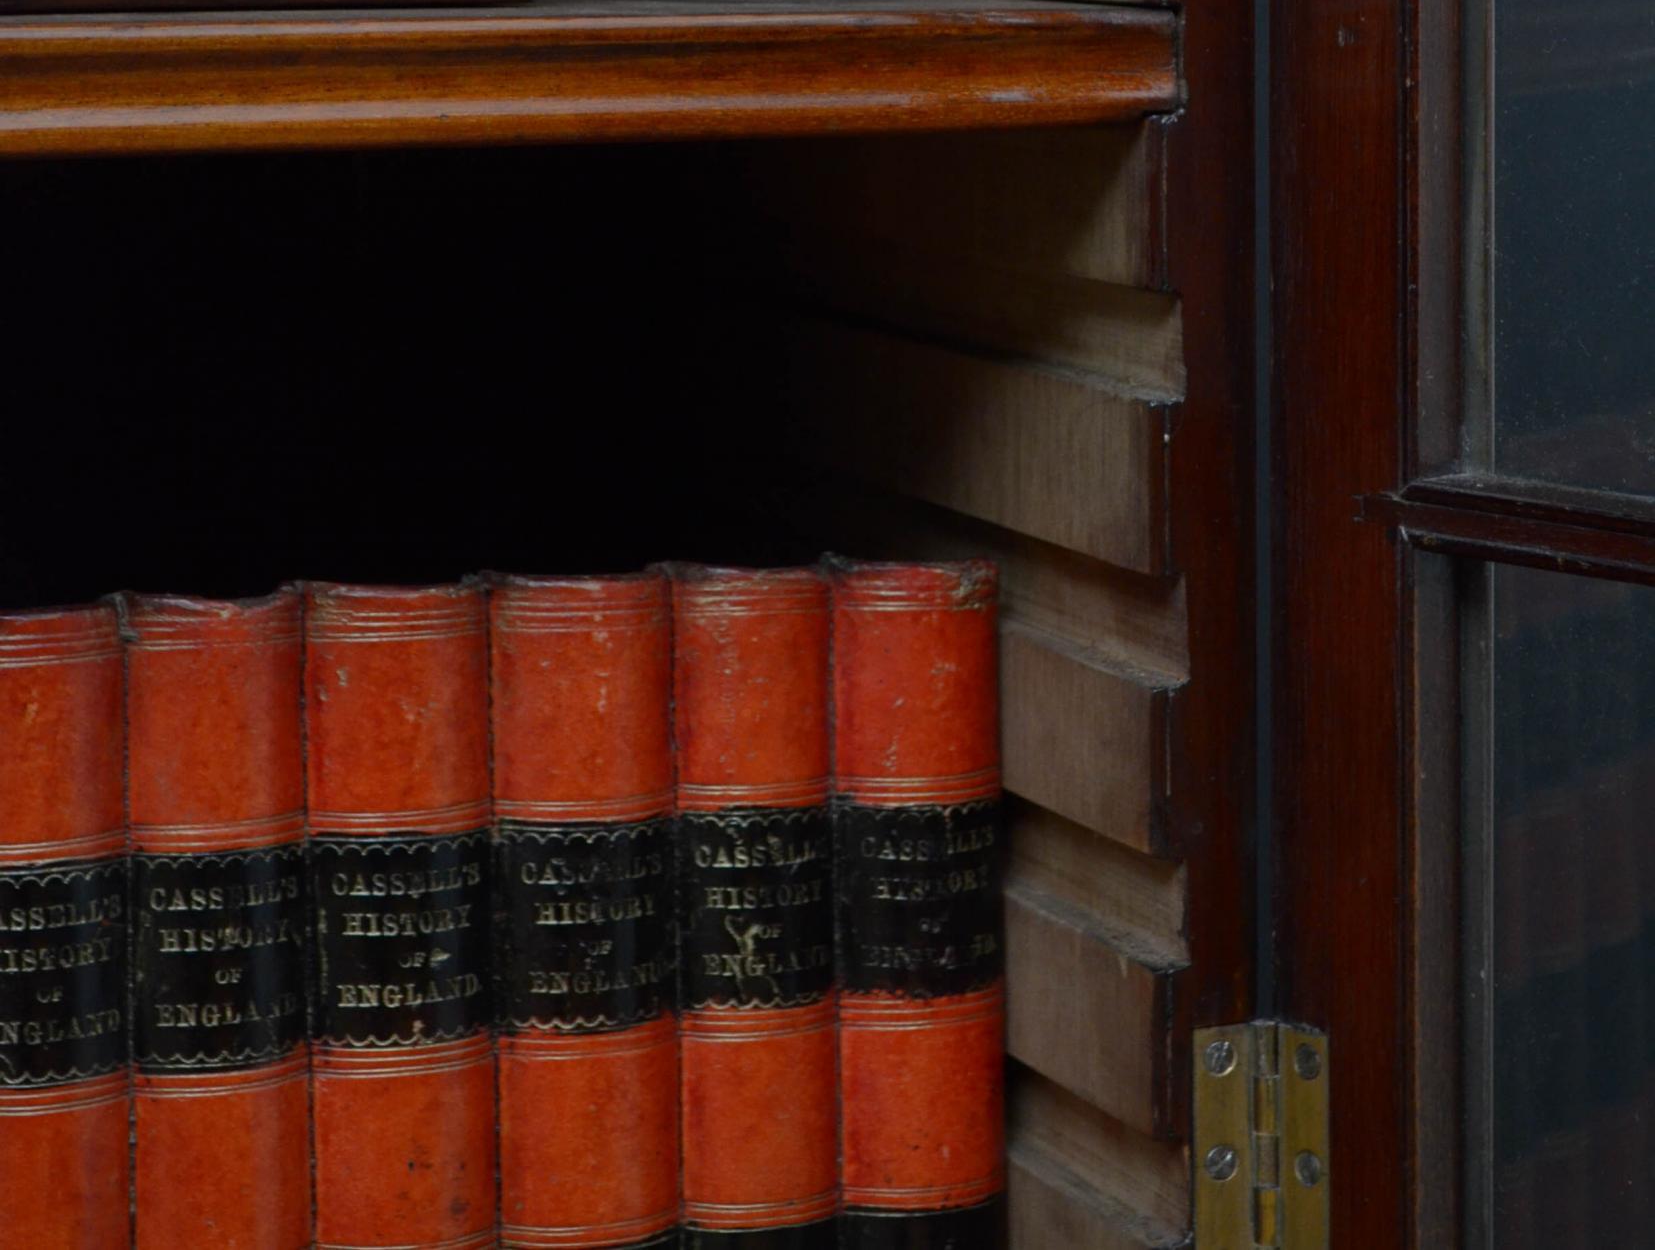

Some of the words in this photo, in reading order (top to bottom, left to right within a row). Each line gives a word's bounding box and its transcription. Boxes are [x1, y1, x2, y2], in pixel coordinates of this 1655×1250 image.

[332, 862, 480, 896] CASSELL'S
[704, 878, 822, 910] HISTORY
[341, 904, 472, 937] HISTORY
[534, 894, 656, 925] HISTORY
[159, 918, 290, 953] HISTORY
[757, 924, 783, 939] OF
[0, 937, 112, 972] ISTORY
[215, 967, 244, 985] OF
[336, 973, 481, 1008] ENGLAND
[36, 986, 64, 1003] OF
